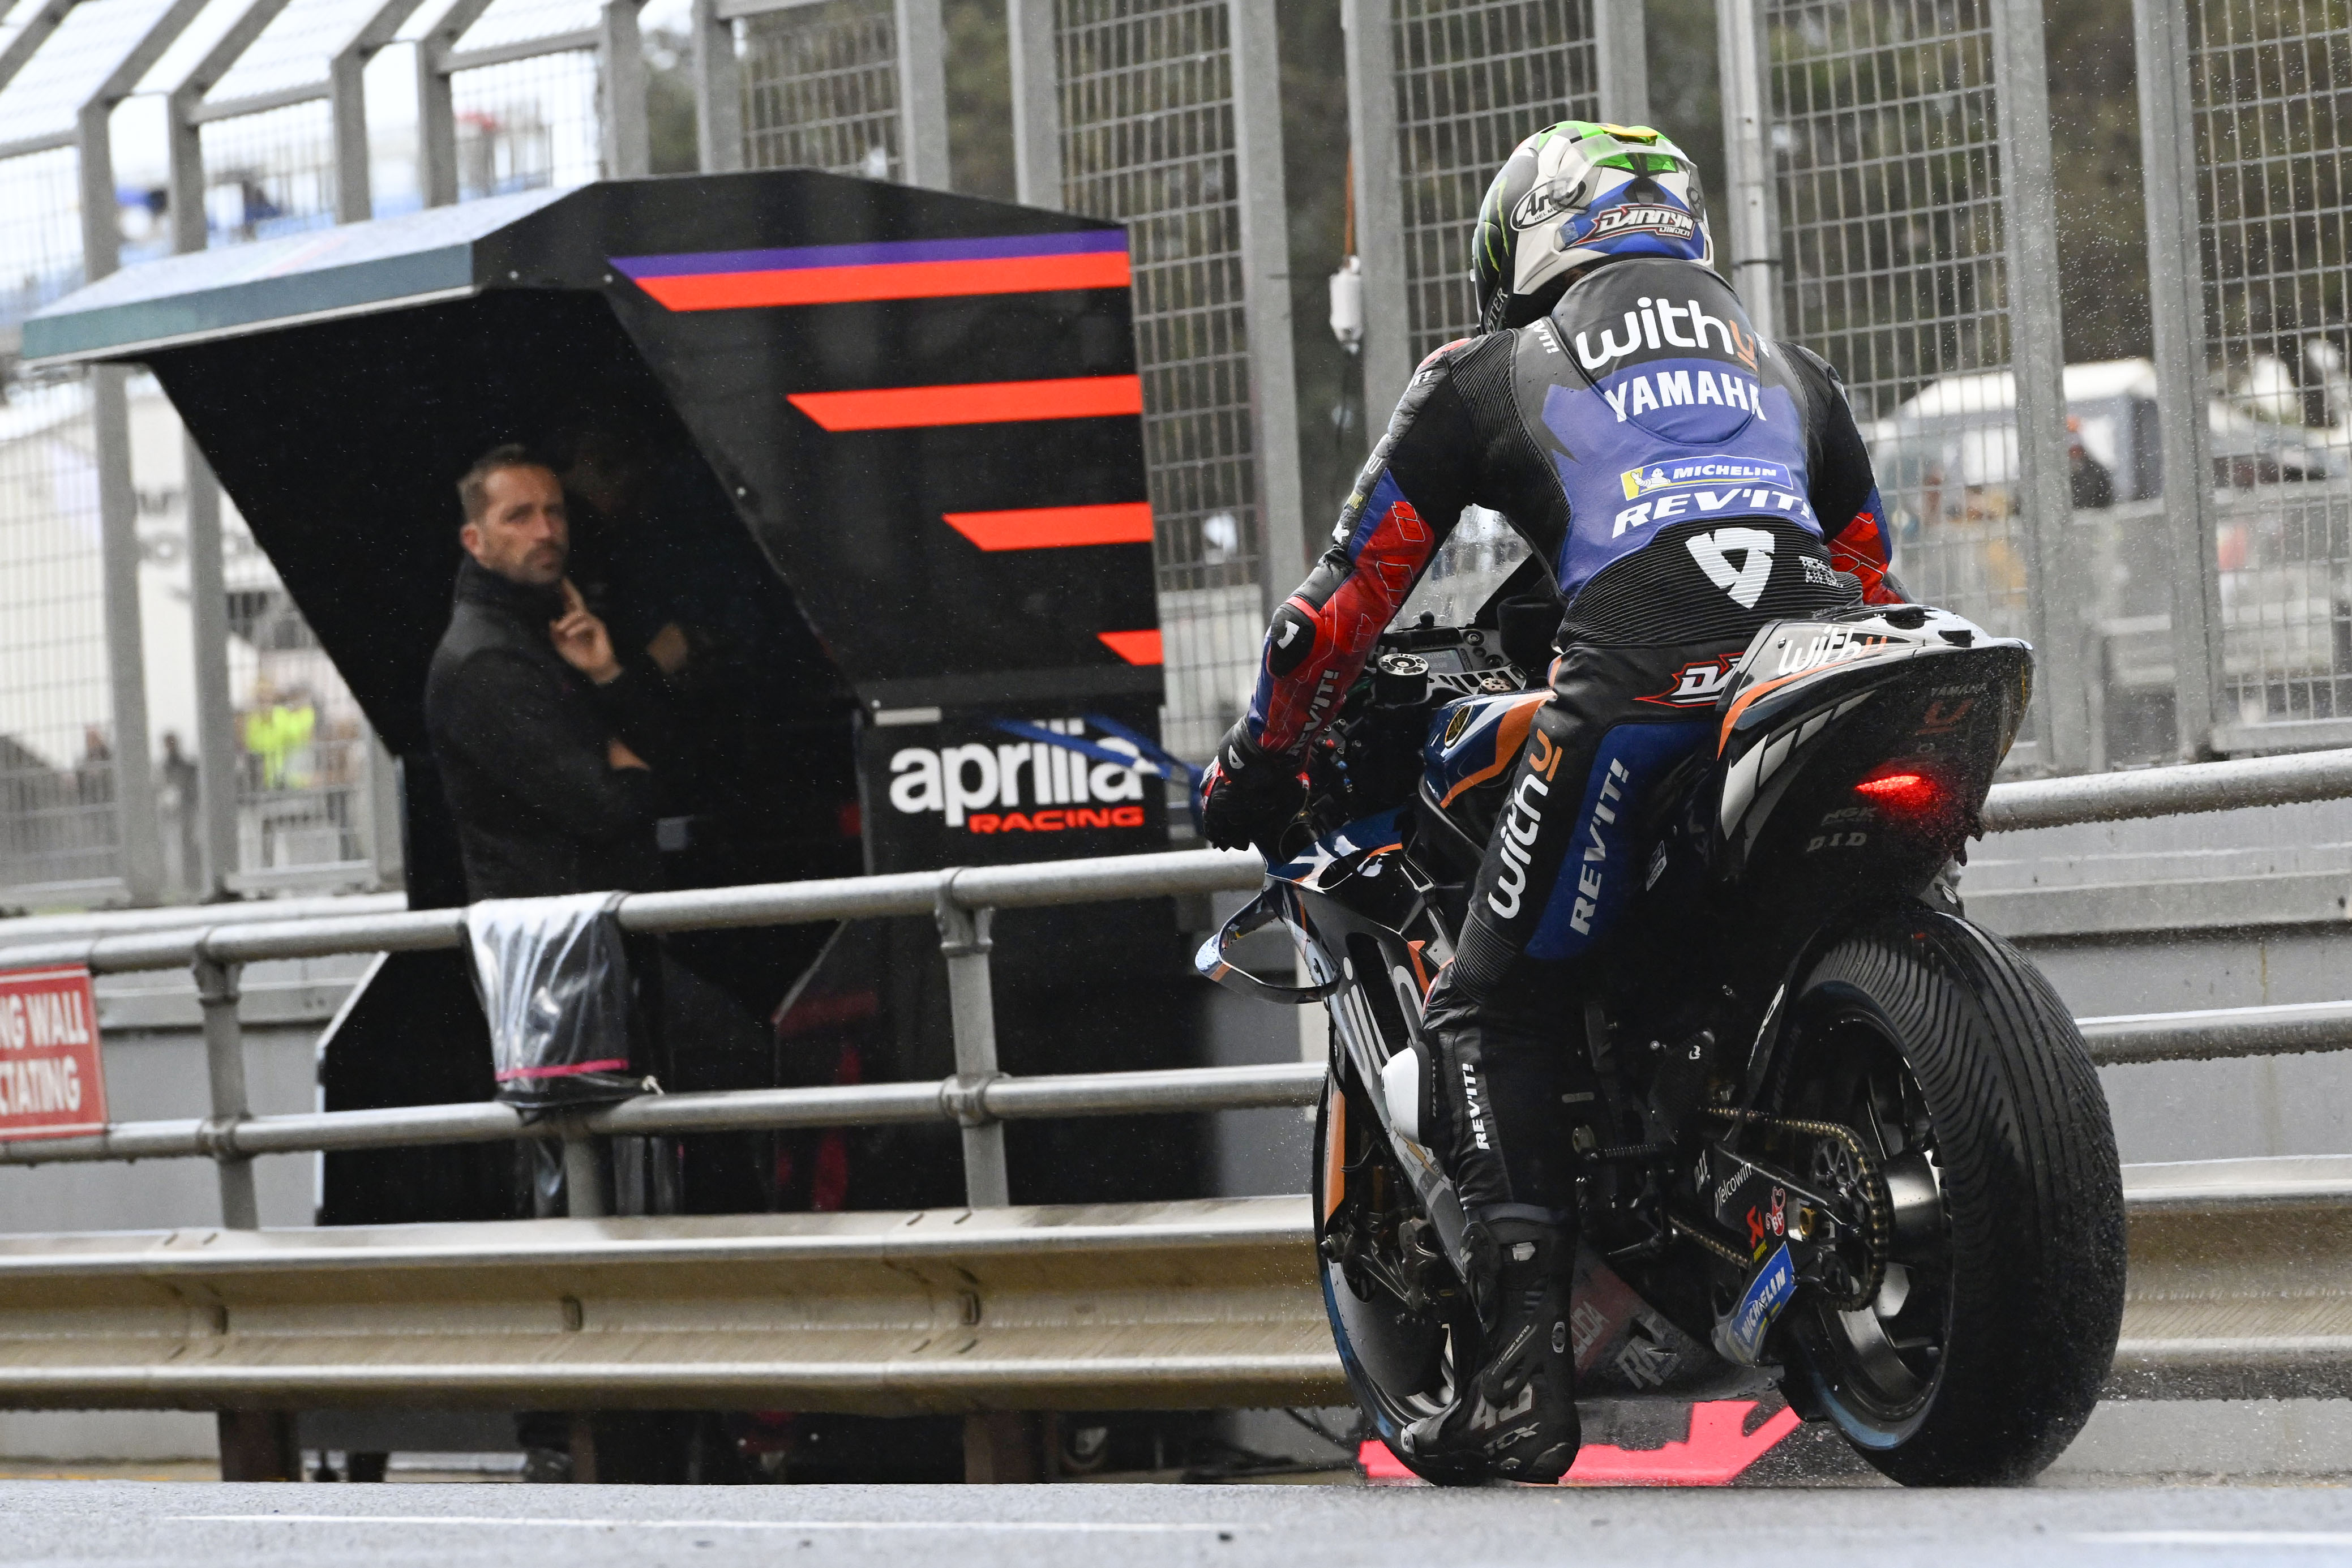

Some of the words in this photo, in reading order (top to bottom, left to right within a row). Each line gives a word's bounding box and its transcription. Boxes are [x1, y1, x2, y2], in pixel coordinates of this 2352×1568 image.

[1673, 464, 1776, 480] MICHELIN
[1612, 487, 1810, 539] REV'IT!
[889, 718, 1155, 827] aprilia
[968, 806, 1145, 834] RACING
[1569, 757, 1630, 935] REV'IT!
[25, 989, 89, 1047] WALL
[1462, 1063, 1490, 1150] REV'IT!
[1741, 1267, 1786, 1343] MICHELIN
